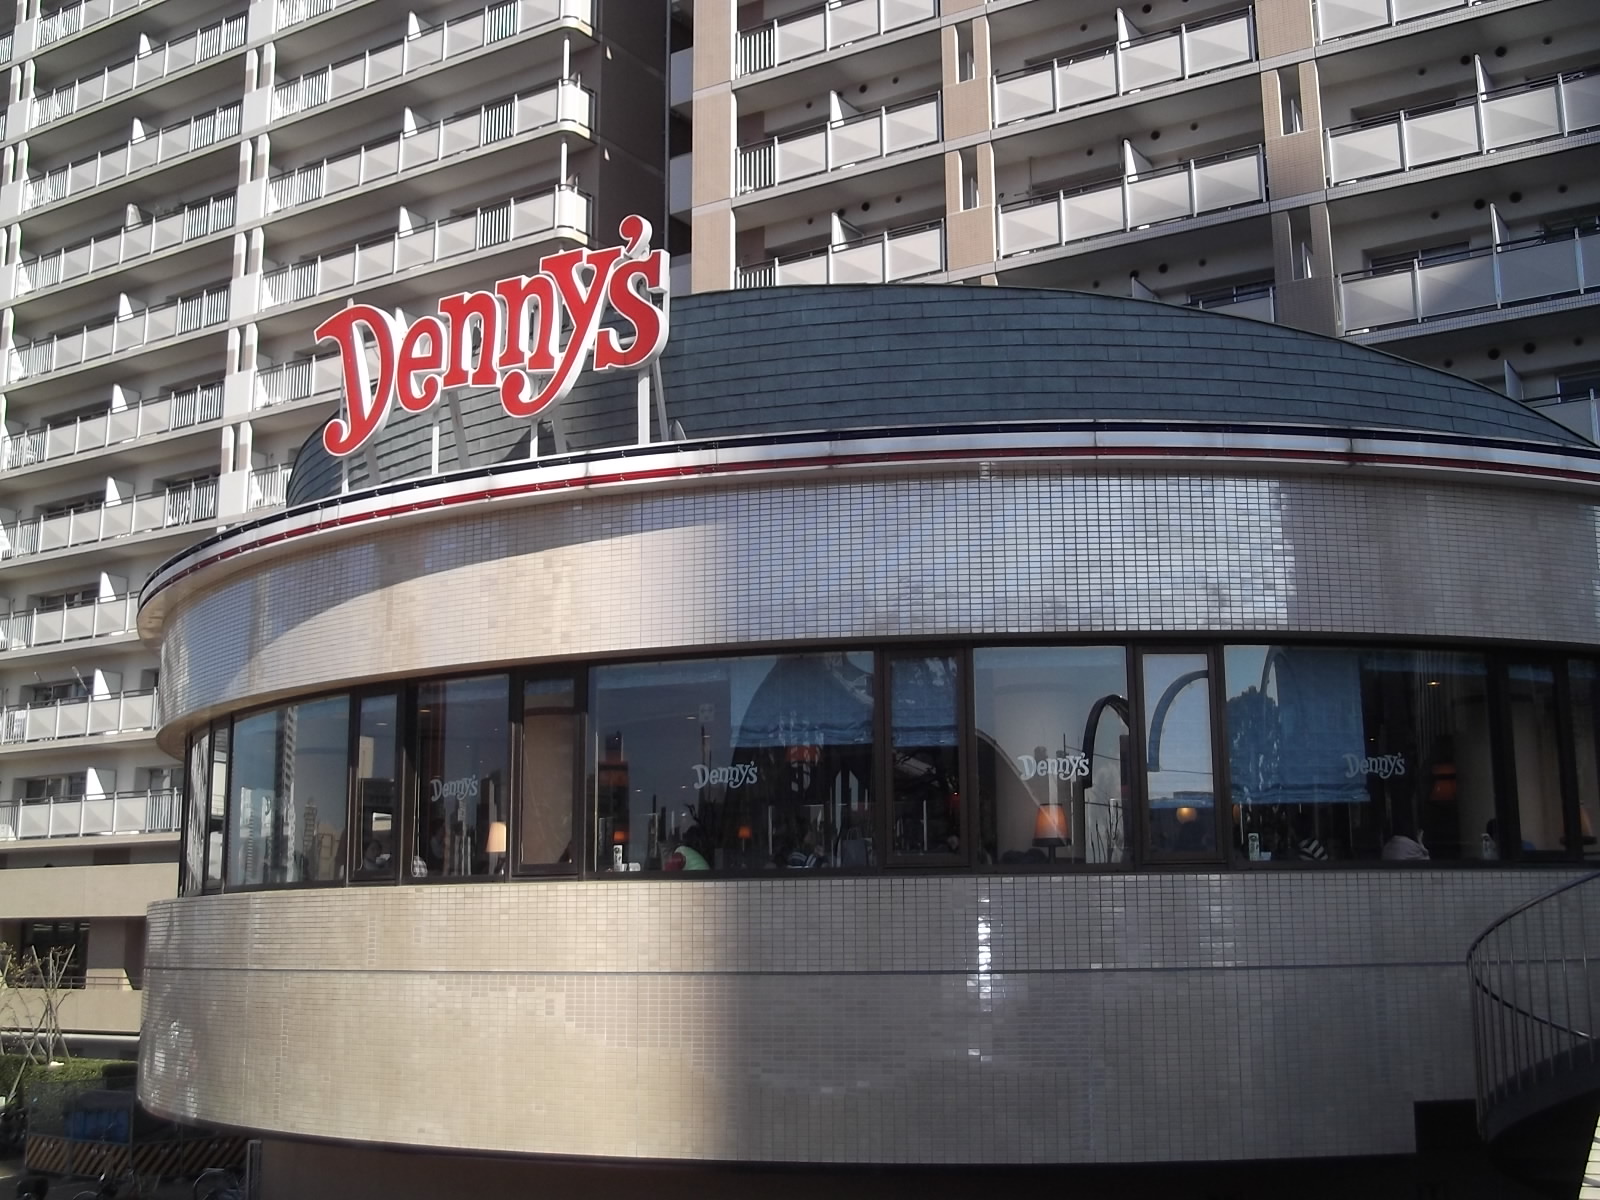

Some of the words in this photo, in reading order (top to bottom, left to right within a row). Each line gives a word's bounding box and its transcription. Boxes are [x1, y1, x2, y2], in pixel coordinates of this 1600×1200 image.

[314, 214, 669, 456] Denny's
[691, 760, 758, 789] Denny's
[1017, 752, 1089, 780] Denny's
[1342, 752, 1406, 779] Denny's
[430, 774, 478, 802] Denny's
